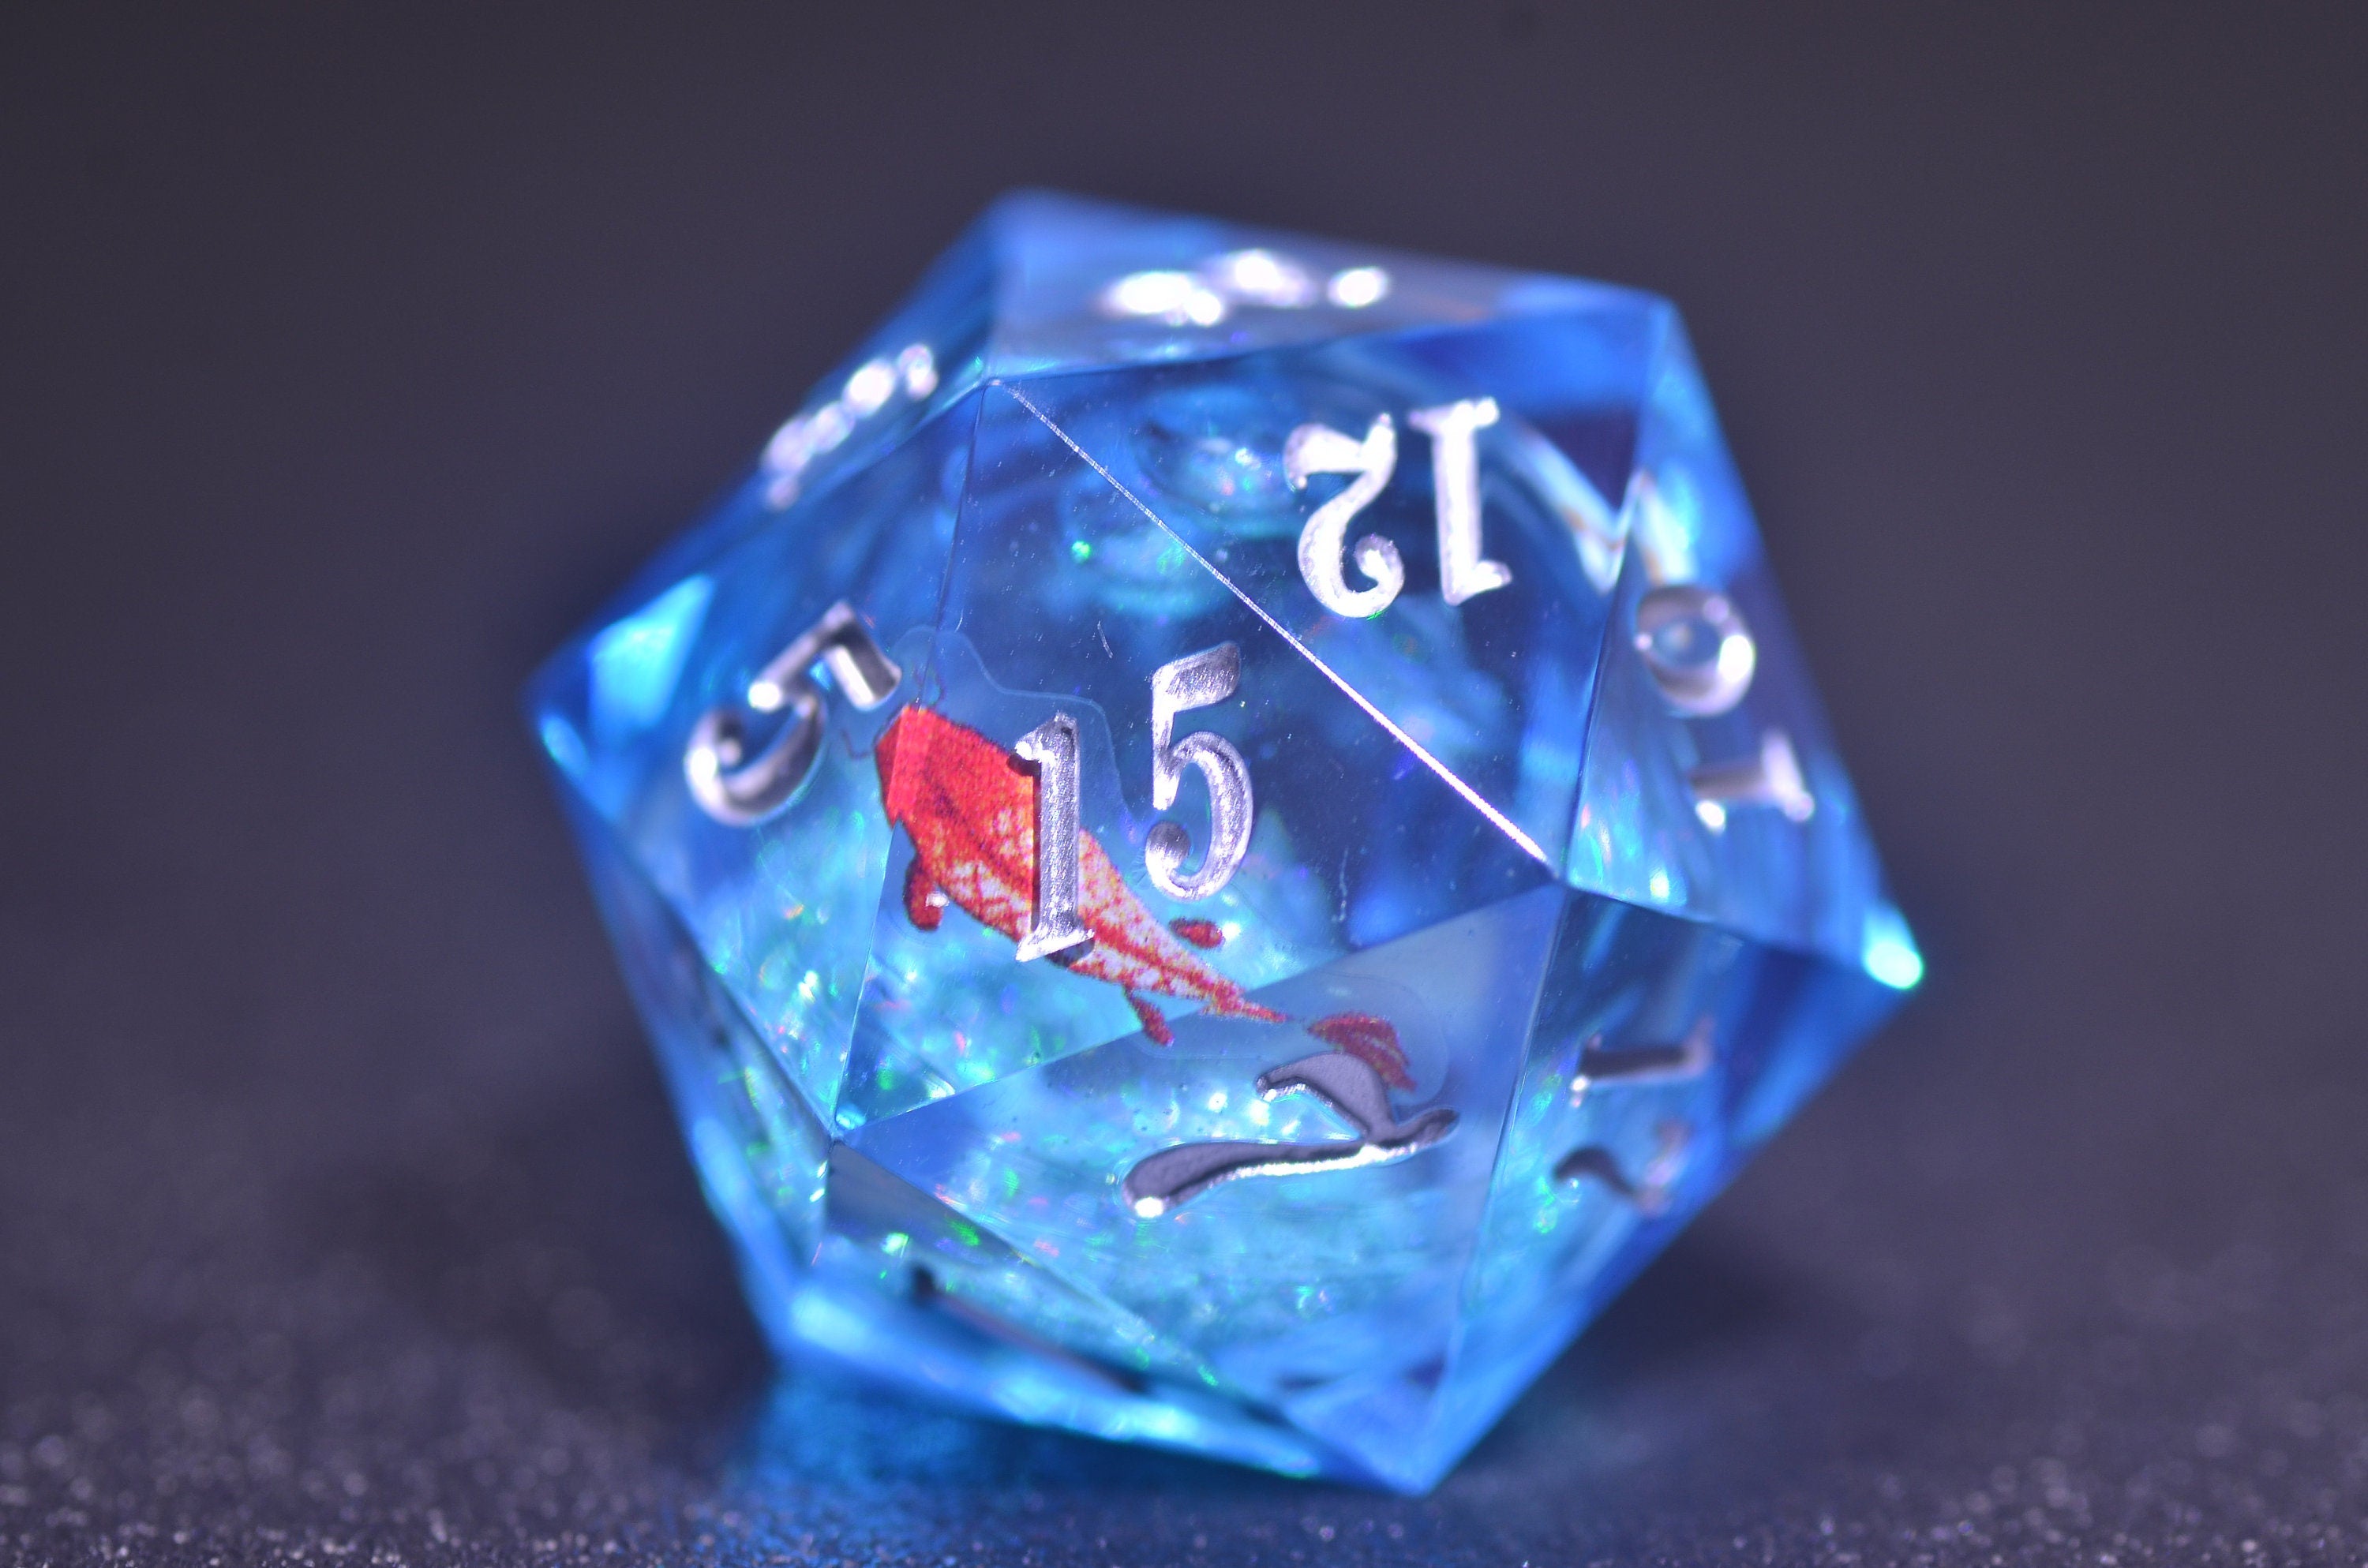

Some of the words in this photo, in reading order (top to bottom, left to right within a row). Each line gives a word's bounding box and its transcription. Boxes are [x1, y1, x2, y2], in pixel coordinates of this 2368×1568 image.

[1284, 397, 1512, 618] 12
[684, 598, 902, 827] 5
[1014, 642, 1254, 963] 15
[1637, 584, 1815, 838] 10
